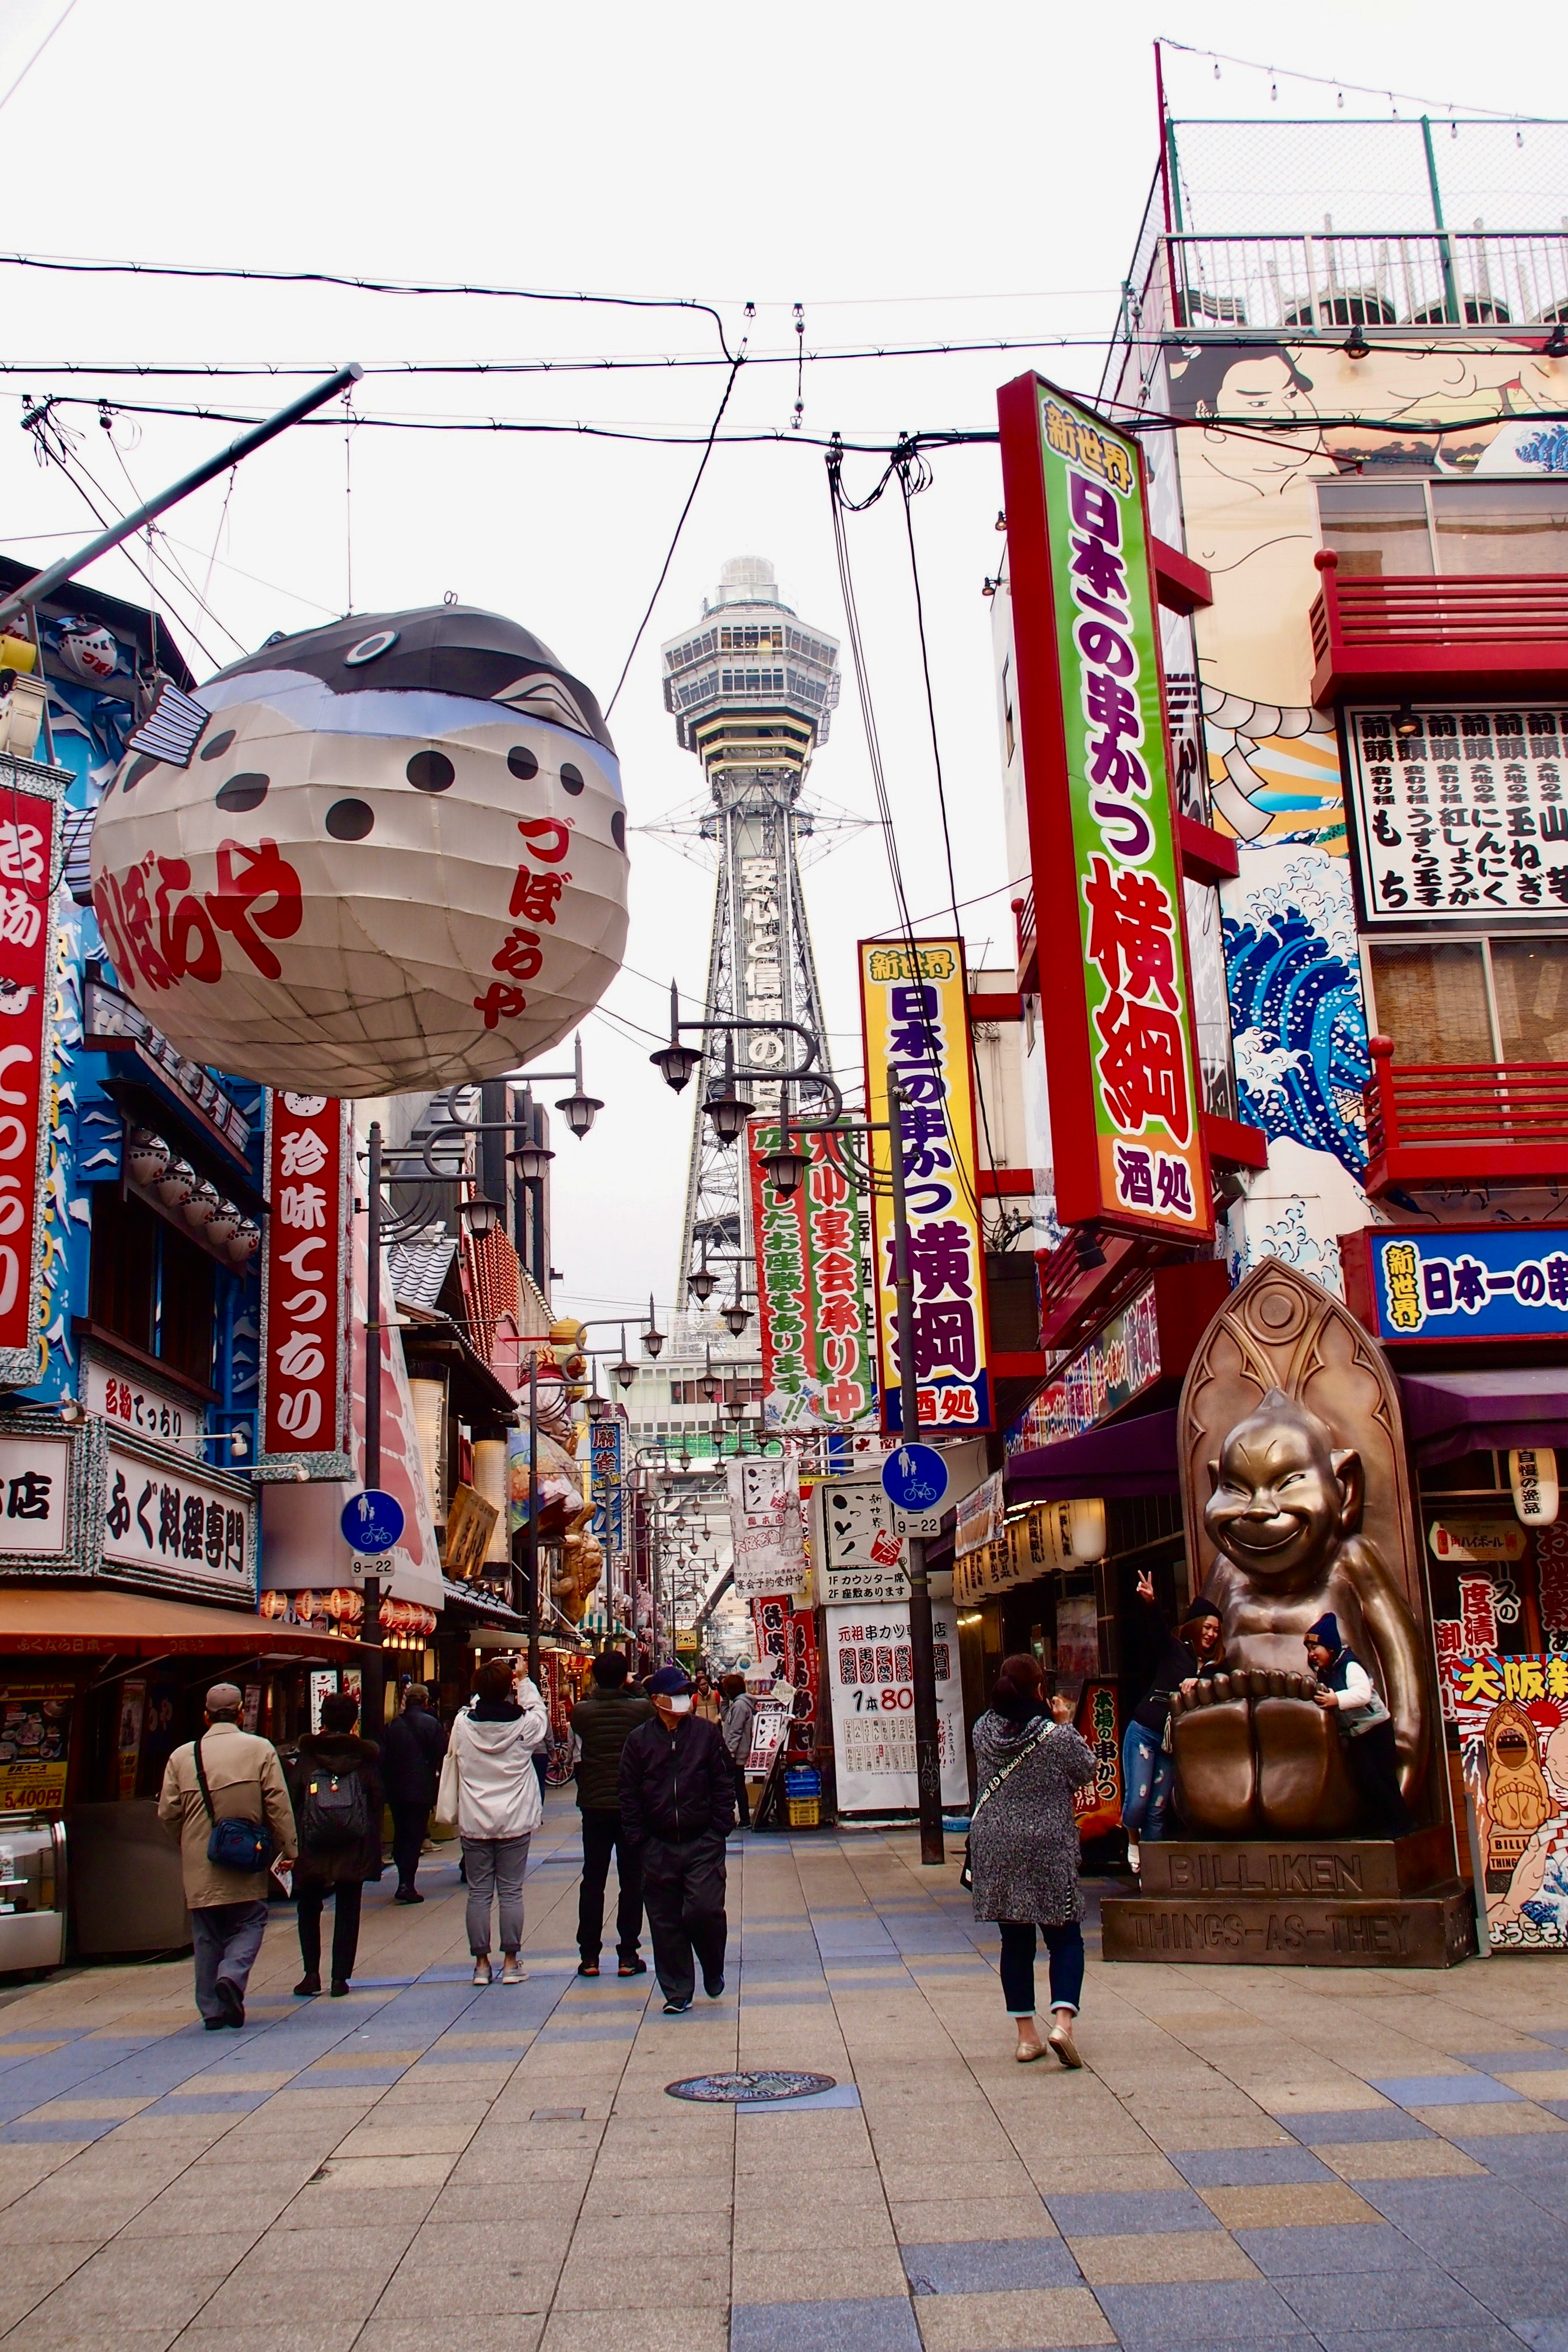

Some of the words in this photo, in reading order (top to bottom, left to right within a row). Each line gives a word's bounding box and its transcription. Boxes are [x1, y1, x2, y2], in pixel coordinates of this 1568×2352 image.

[1046, 401, 1132, 492] 新世界
[1360, 716, 1394, 763] 前頭
[1427, 715, 1461, 761] 前頭
[1460, 714, 1494, 761] 前頭
[1493, 713, 1528, 760] 前頭
[1526, 713, 1562, 760] 前頭
[1369, 766, 1396, 806] 変わり種
[1402, 765, 1430, 804] 変わり種
[1436, 765, 1463, 804] 変わり種
[1470, 764, 1496, 803] 大地の幸
[1503, 764, 1530, 803] 大地の幸
[1536, 762, 1563, 803] 大地の幸
[1372, 809, 1409, 908] もち
[1406, 808, 1446, 906] うずら玉子
[1437, 808, 1479, 906] 紅しょうが
[1471, 808, 1508, 905] にんにく
[1506, 806, 1546, 905] 玉ねぎ
[474, 817, 576, 1030] づぼらや
[870, 949, 955, 981] 新世界
[1118, 1146, 1194, 1214] 酒処
[275, 1127, 330, 1439] 珍味てっちり
[1386, 1245, 1422, 1328] 新世界
[106, 1378, 182, 1443] 名物てっちり
[592, 1425, 618, 1475] 麻雀
[0, 1471, 53, 1520] 店
[869, 1493, 886, 1529] 新世界
[107, 1468, 244, 1573] ふぐ料理専門
[828, 1576, 838, 1586] 1F
[841, 1573, 904, 1586] カウンター席
[828, 1589, 839, 1599] 2F
[842, 1586, 905, 1600] 座敷あります
[838, 1621, 949, 1643] 元祖串カツ店
[842, 1649, 856, 1684] 大阪名物
[859, 1648, 874, 1684] 串カツ
[895, 1646, 911, 1682] 焼きそば
[855, 1726, 861, 1738] ハム
[1094, 1690, 1118, 1799] 本場の串かつ
[5, 1789, 62, 1808] 5,400円
[1168, 1853, 1363, 1892] BILLIKEN
[1129, 1912, 1410, 1957] THINGS-AS-THEY
